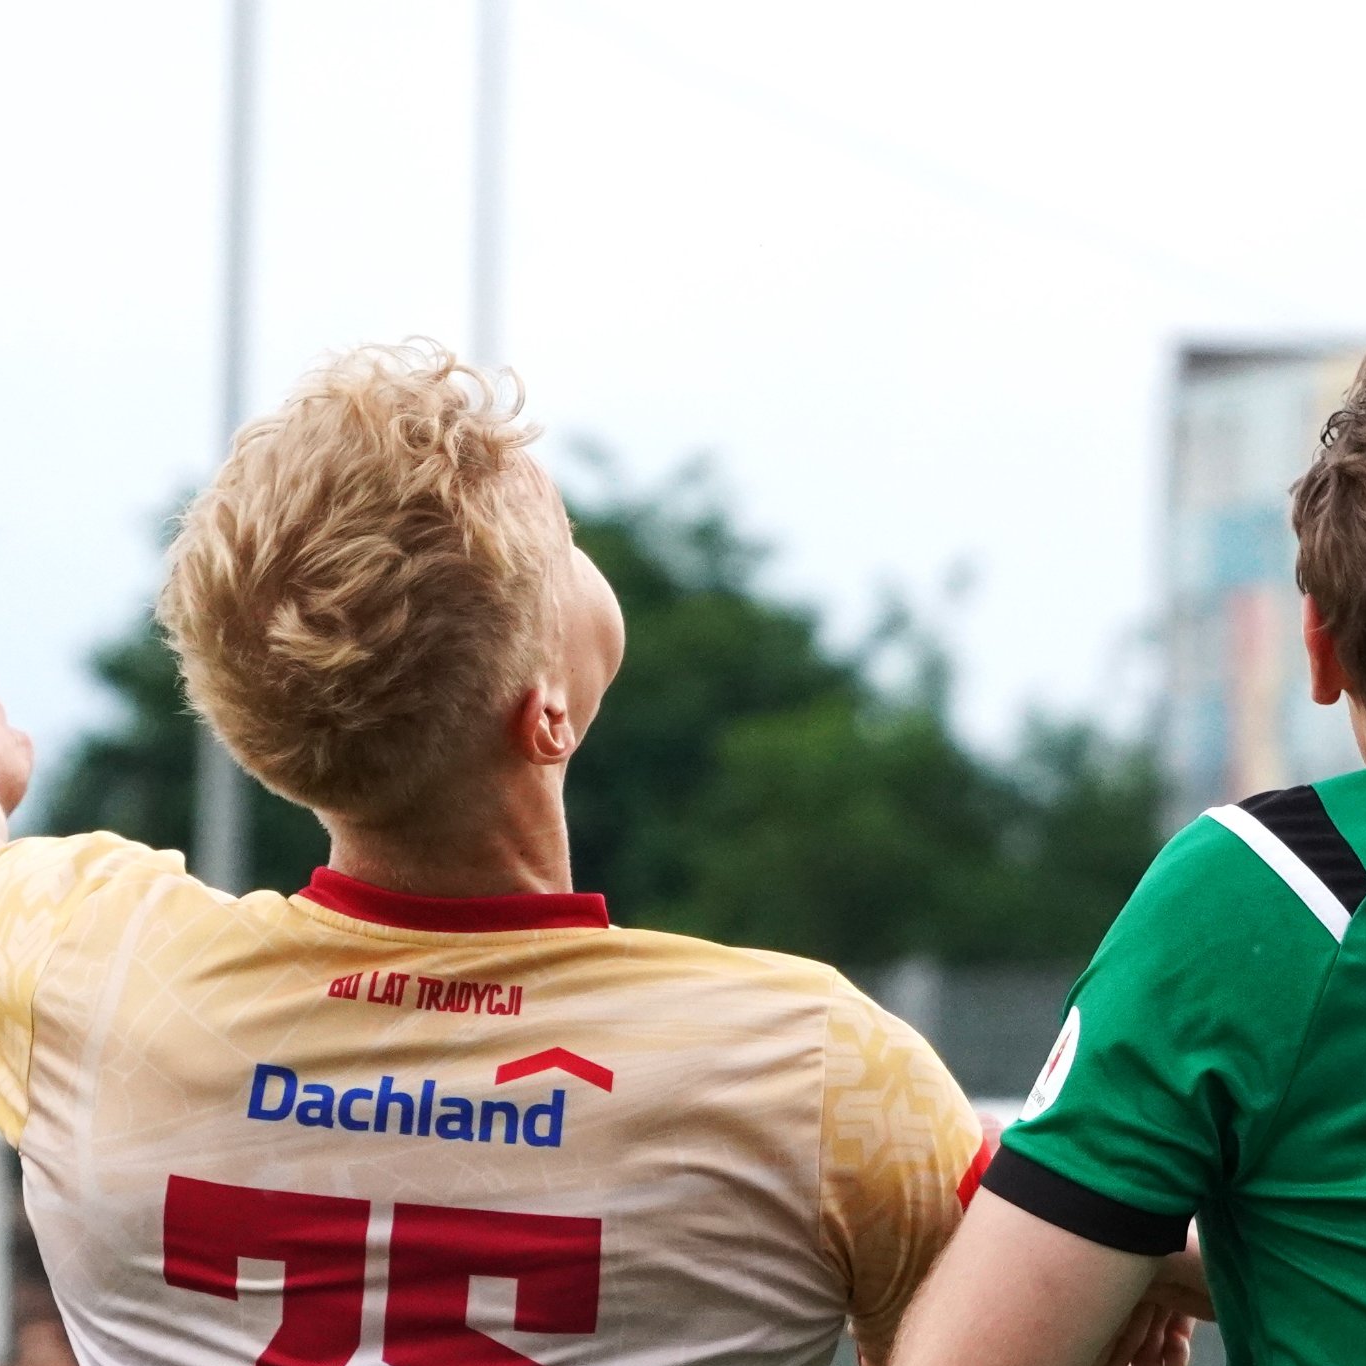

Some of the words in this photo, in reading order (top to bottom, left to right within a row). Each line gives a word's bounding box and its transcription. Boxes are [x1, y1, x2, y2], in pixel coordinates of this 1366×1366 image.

[367, 971, 410, 1006] LAT
[415, 976, 523, 1016] TRADYCJI
[247, 1063, 566, 1148] Dachland
